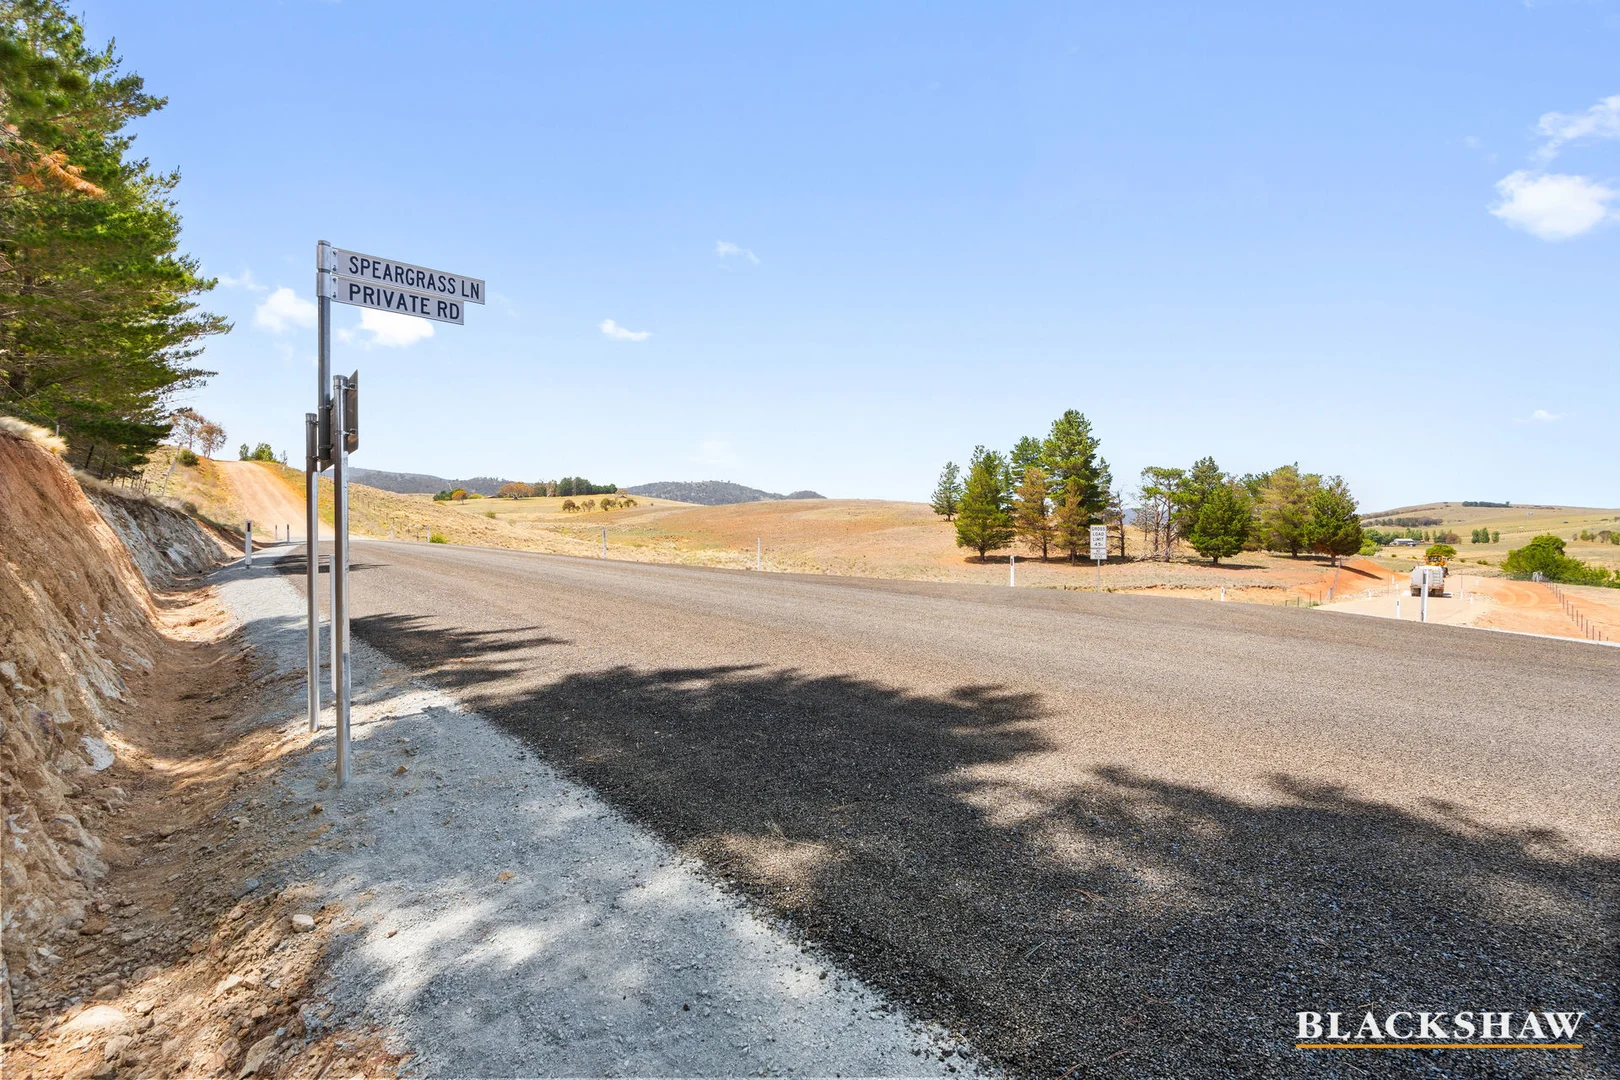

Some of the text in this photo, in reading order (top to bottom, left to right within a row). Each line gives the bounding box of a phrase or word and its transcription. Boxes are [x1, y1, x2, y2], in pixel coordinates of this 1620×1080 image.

[349, 256, 480, 300] SPEARGRASS LN
[349, 283, 460, 320] PRIVATE RD
